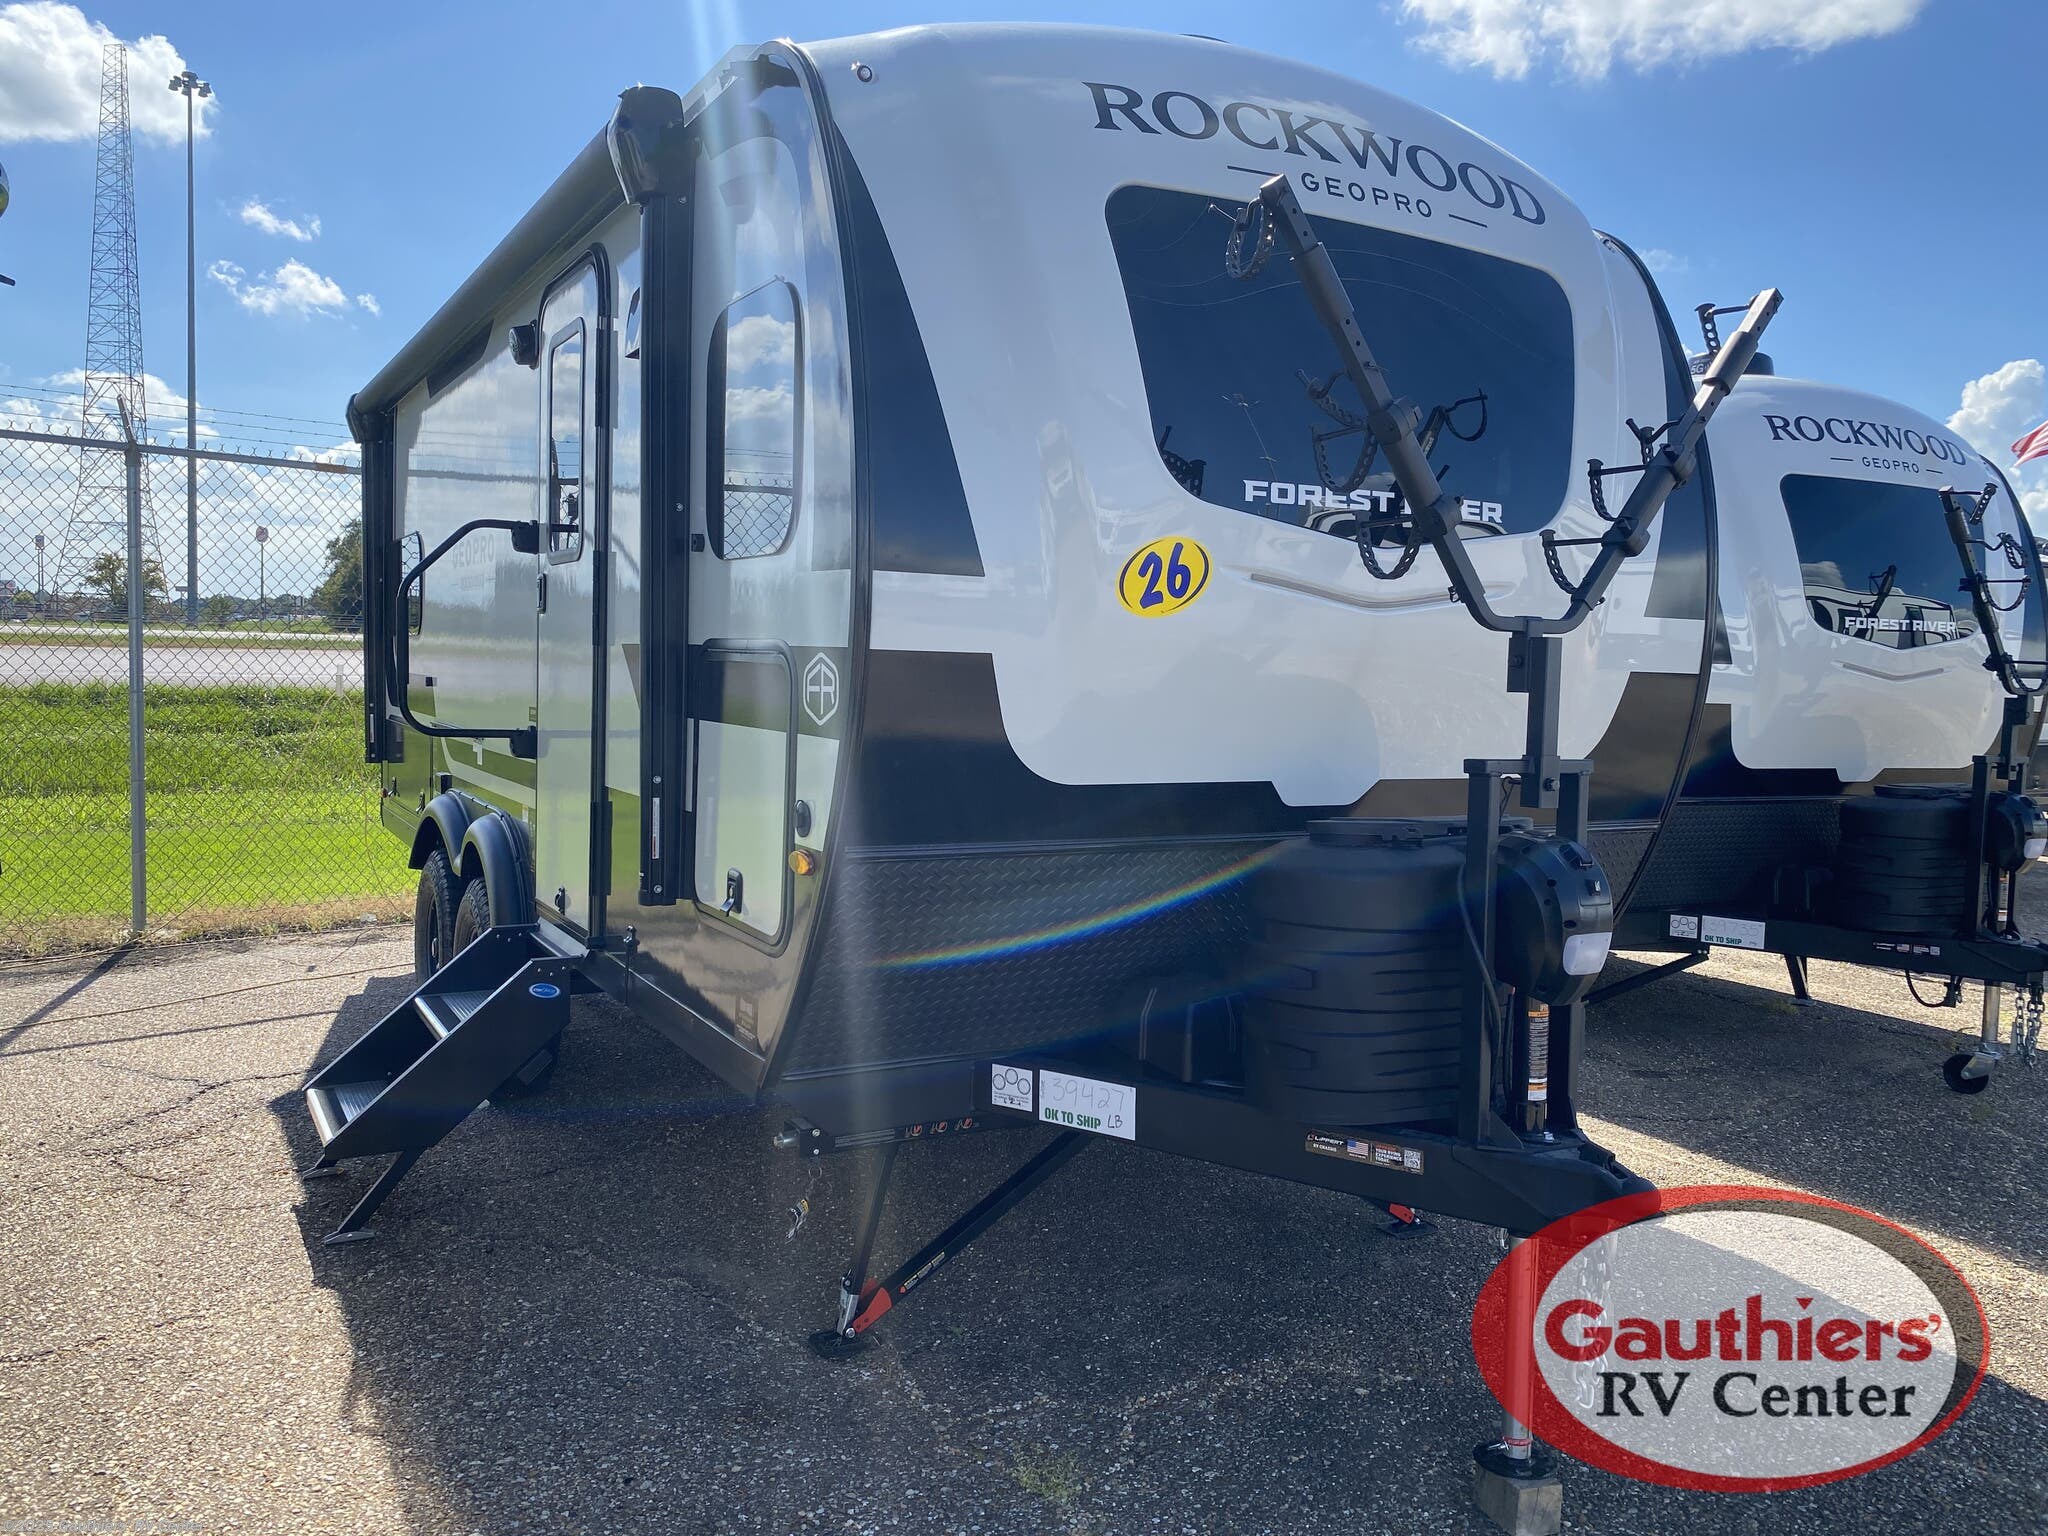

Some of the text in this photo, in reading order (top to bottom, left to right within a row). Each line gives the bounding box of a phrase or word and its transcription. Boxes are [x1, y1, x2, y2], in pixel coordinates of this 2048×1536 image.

[1081, 81, 1547, 226] ROCKWOOD
[1301, 172, 1433, 218] GEOPRO
[1763, 414, 1966, 466] ROCKWOOD
[1861, 456, 1921, 474] GEOPRO
[1243, 479, 1396, 513] FOREST
[1137, 542, 1191, 609] 26
[1844, 616, 1957, 633] FOREST RIVER
[1704, 934, 1714, 942] OK
[1716, 935, 1725, 943] TO
[1726, 937, 1743, 945] SHIP
[1044, 1107, 1101, 1130] OK TO SHIP
